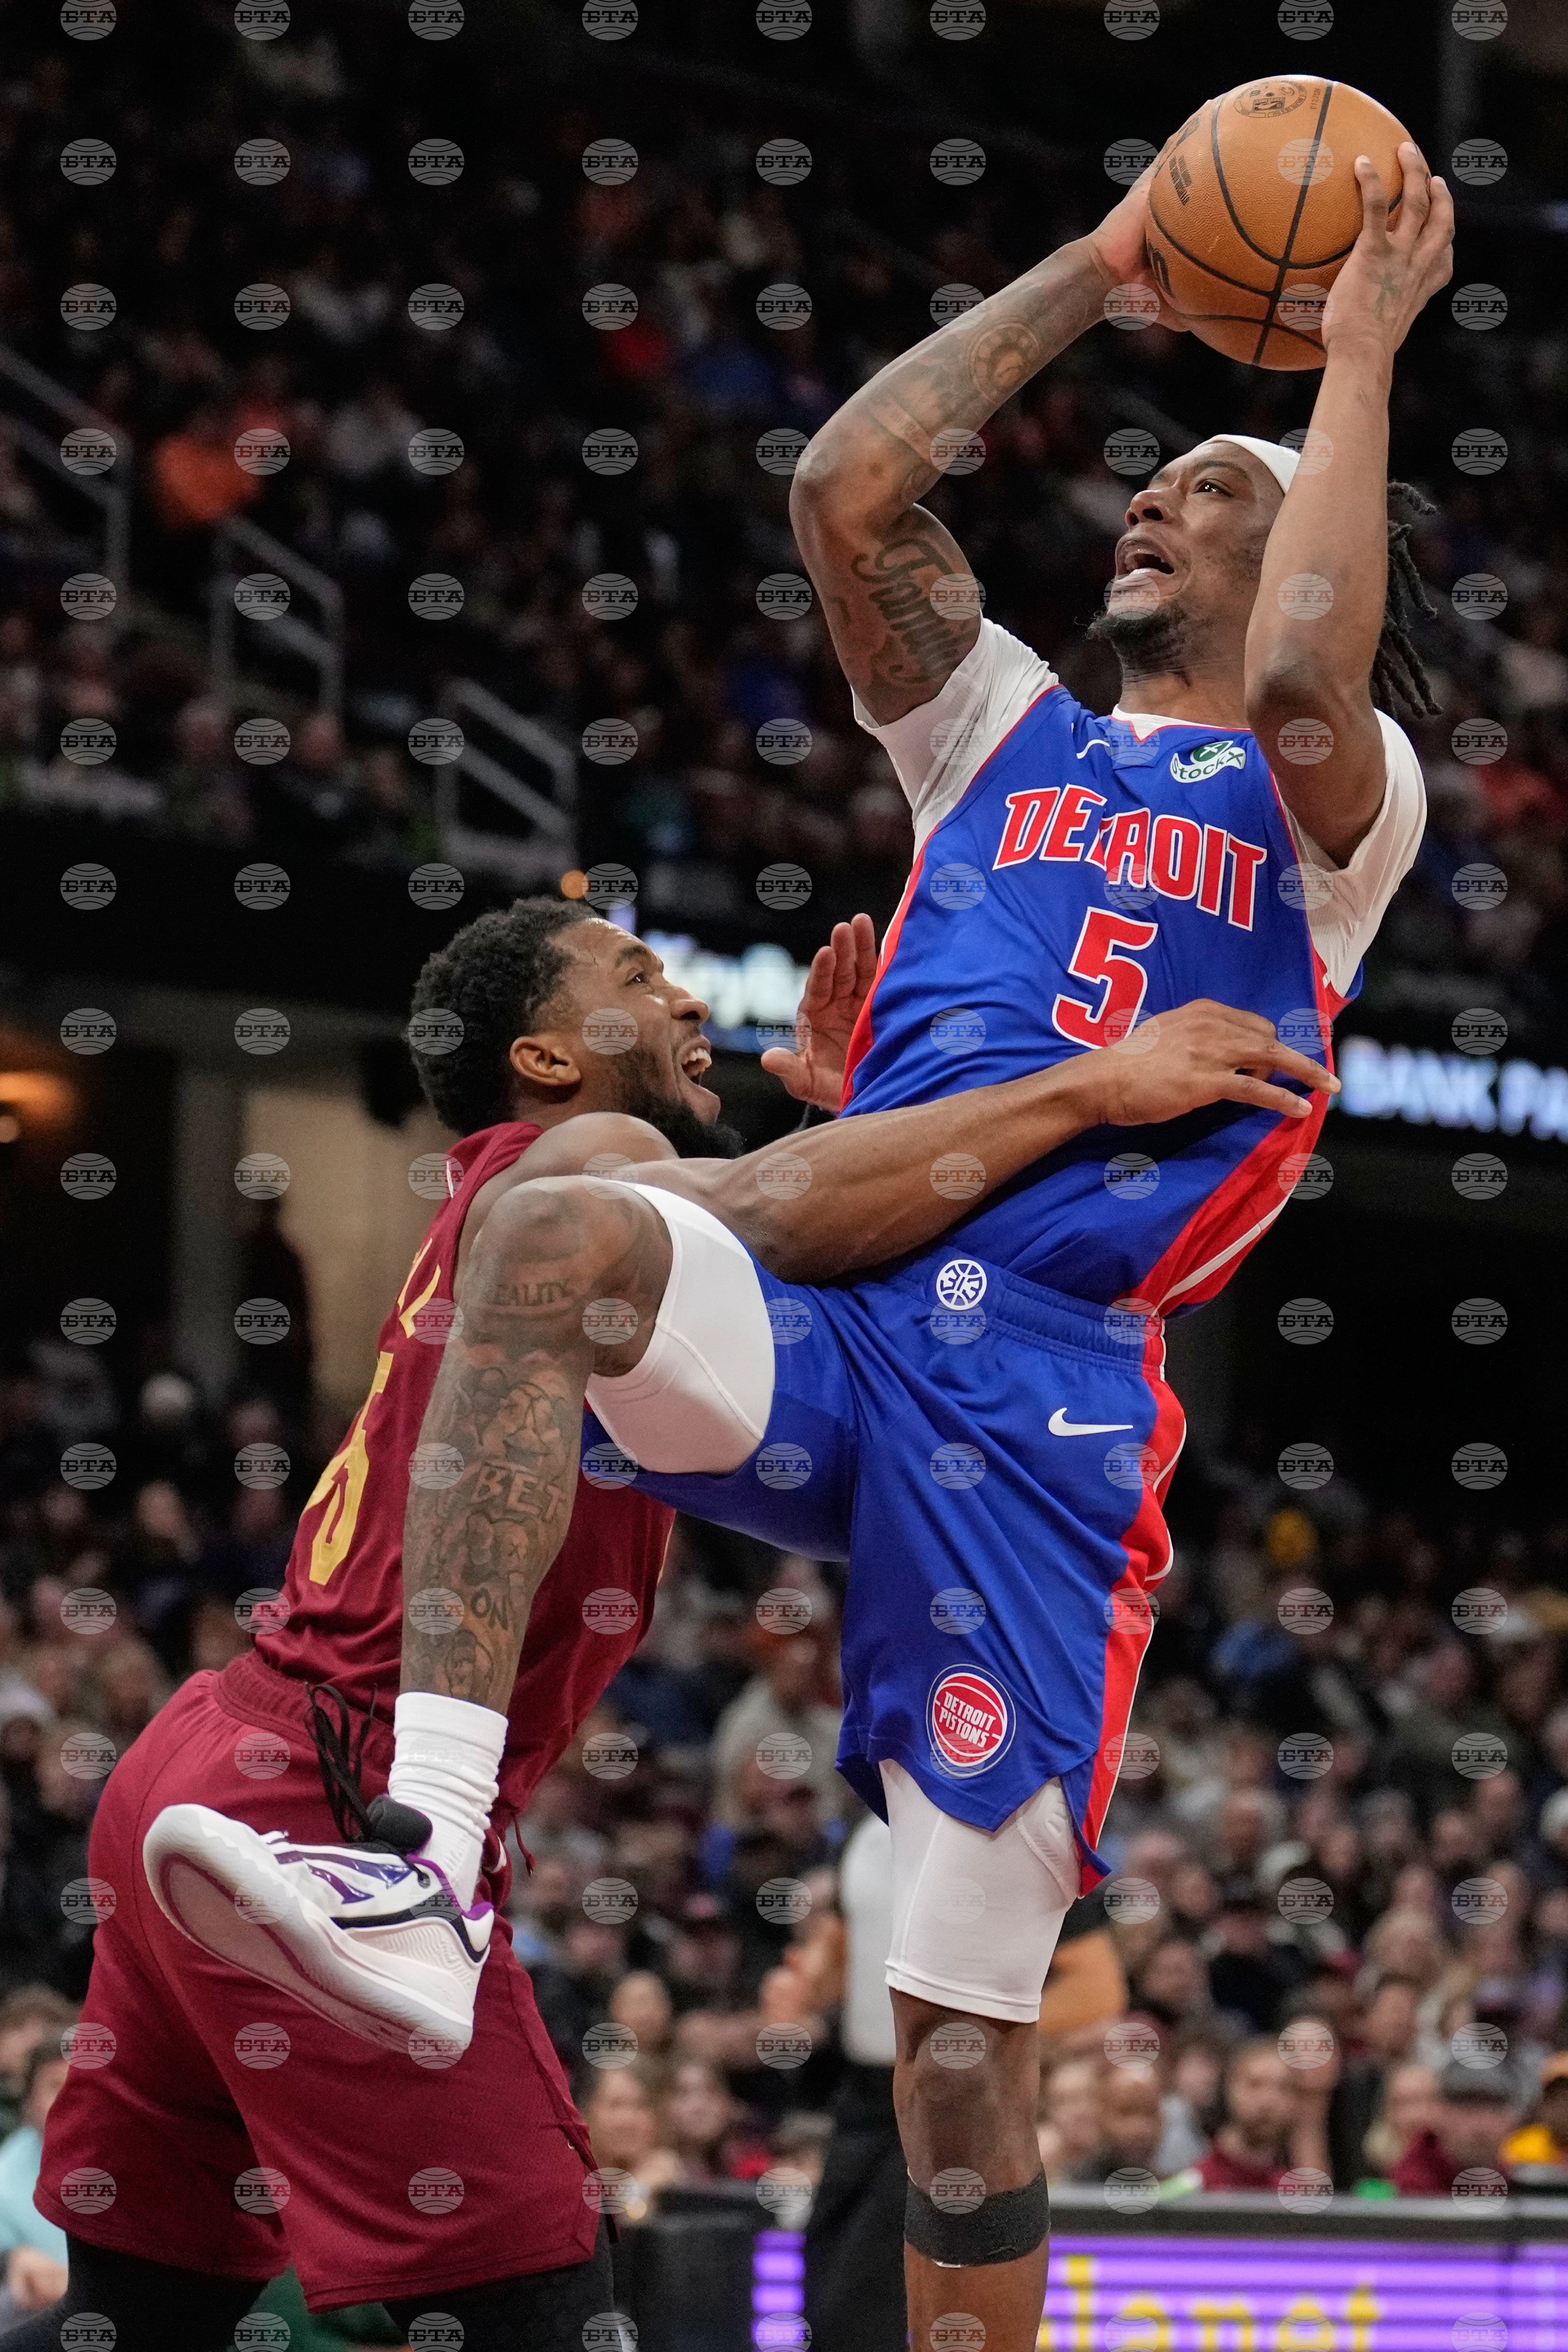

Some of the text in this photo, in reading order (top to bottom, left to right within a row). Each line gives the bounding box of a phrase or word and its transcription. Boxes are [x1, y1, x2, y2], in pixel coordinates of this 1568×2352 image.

[1052, 906, 1158, 1050] 5
[939, 1706, 990, 1748] PISTONS
[943, 1691, 997, 1731] DETROIT
